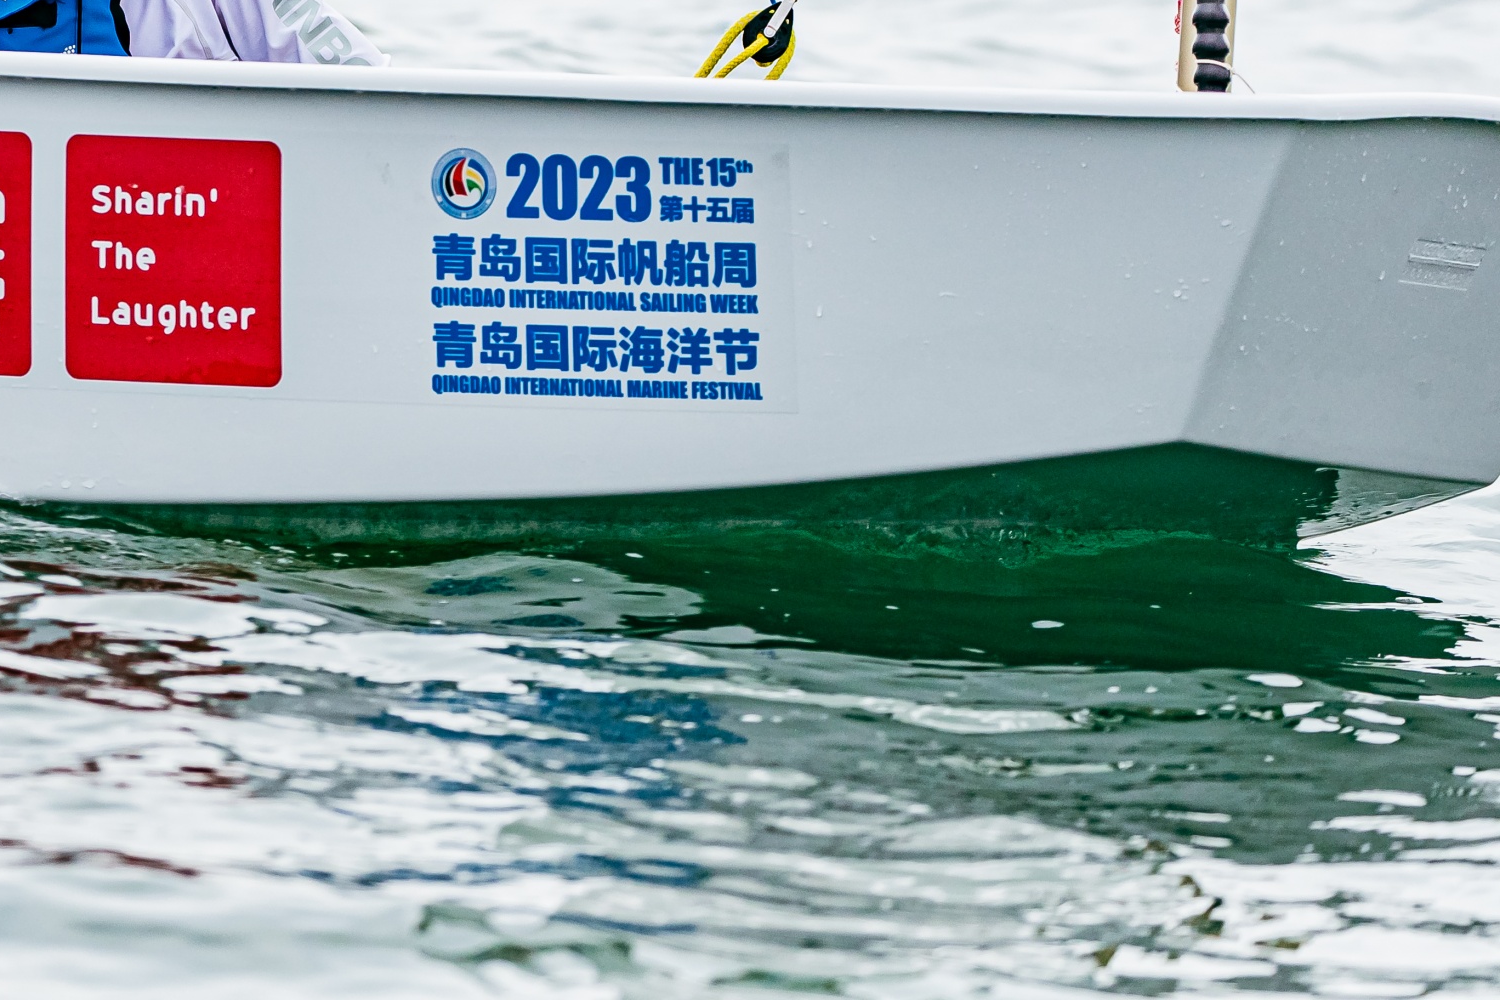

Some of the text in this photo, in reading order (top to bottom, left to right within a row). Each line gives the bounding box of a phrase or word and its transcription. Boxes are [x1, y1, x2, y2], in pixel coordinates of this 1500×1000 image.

[505, 152, 652, 223] 2023
[658, 156, 754, 188] THE 15th
[91, 184, 219, 218] Sharin'
[658, 195, 755, 224] 第十五届
[91, 240, 157, 271] The
[431, 232, 758, 289] 青岛国际帆船周
[91, 296, 256, 335] Laughter
[430, 286, 759, 315] QINGDAO INTERNATIONAL SAILING WEEK
[431, 320, 761, 376] 青岛国际海洋节
[431, 374, 764, 401] QINGDAO INTERNATIONAL MARINE FESTIVAL
